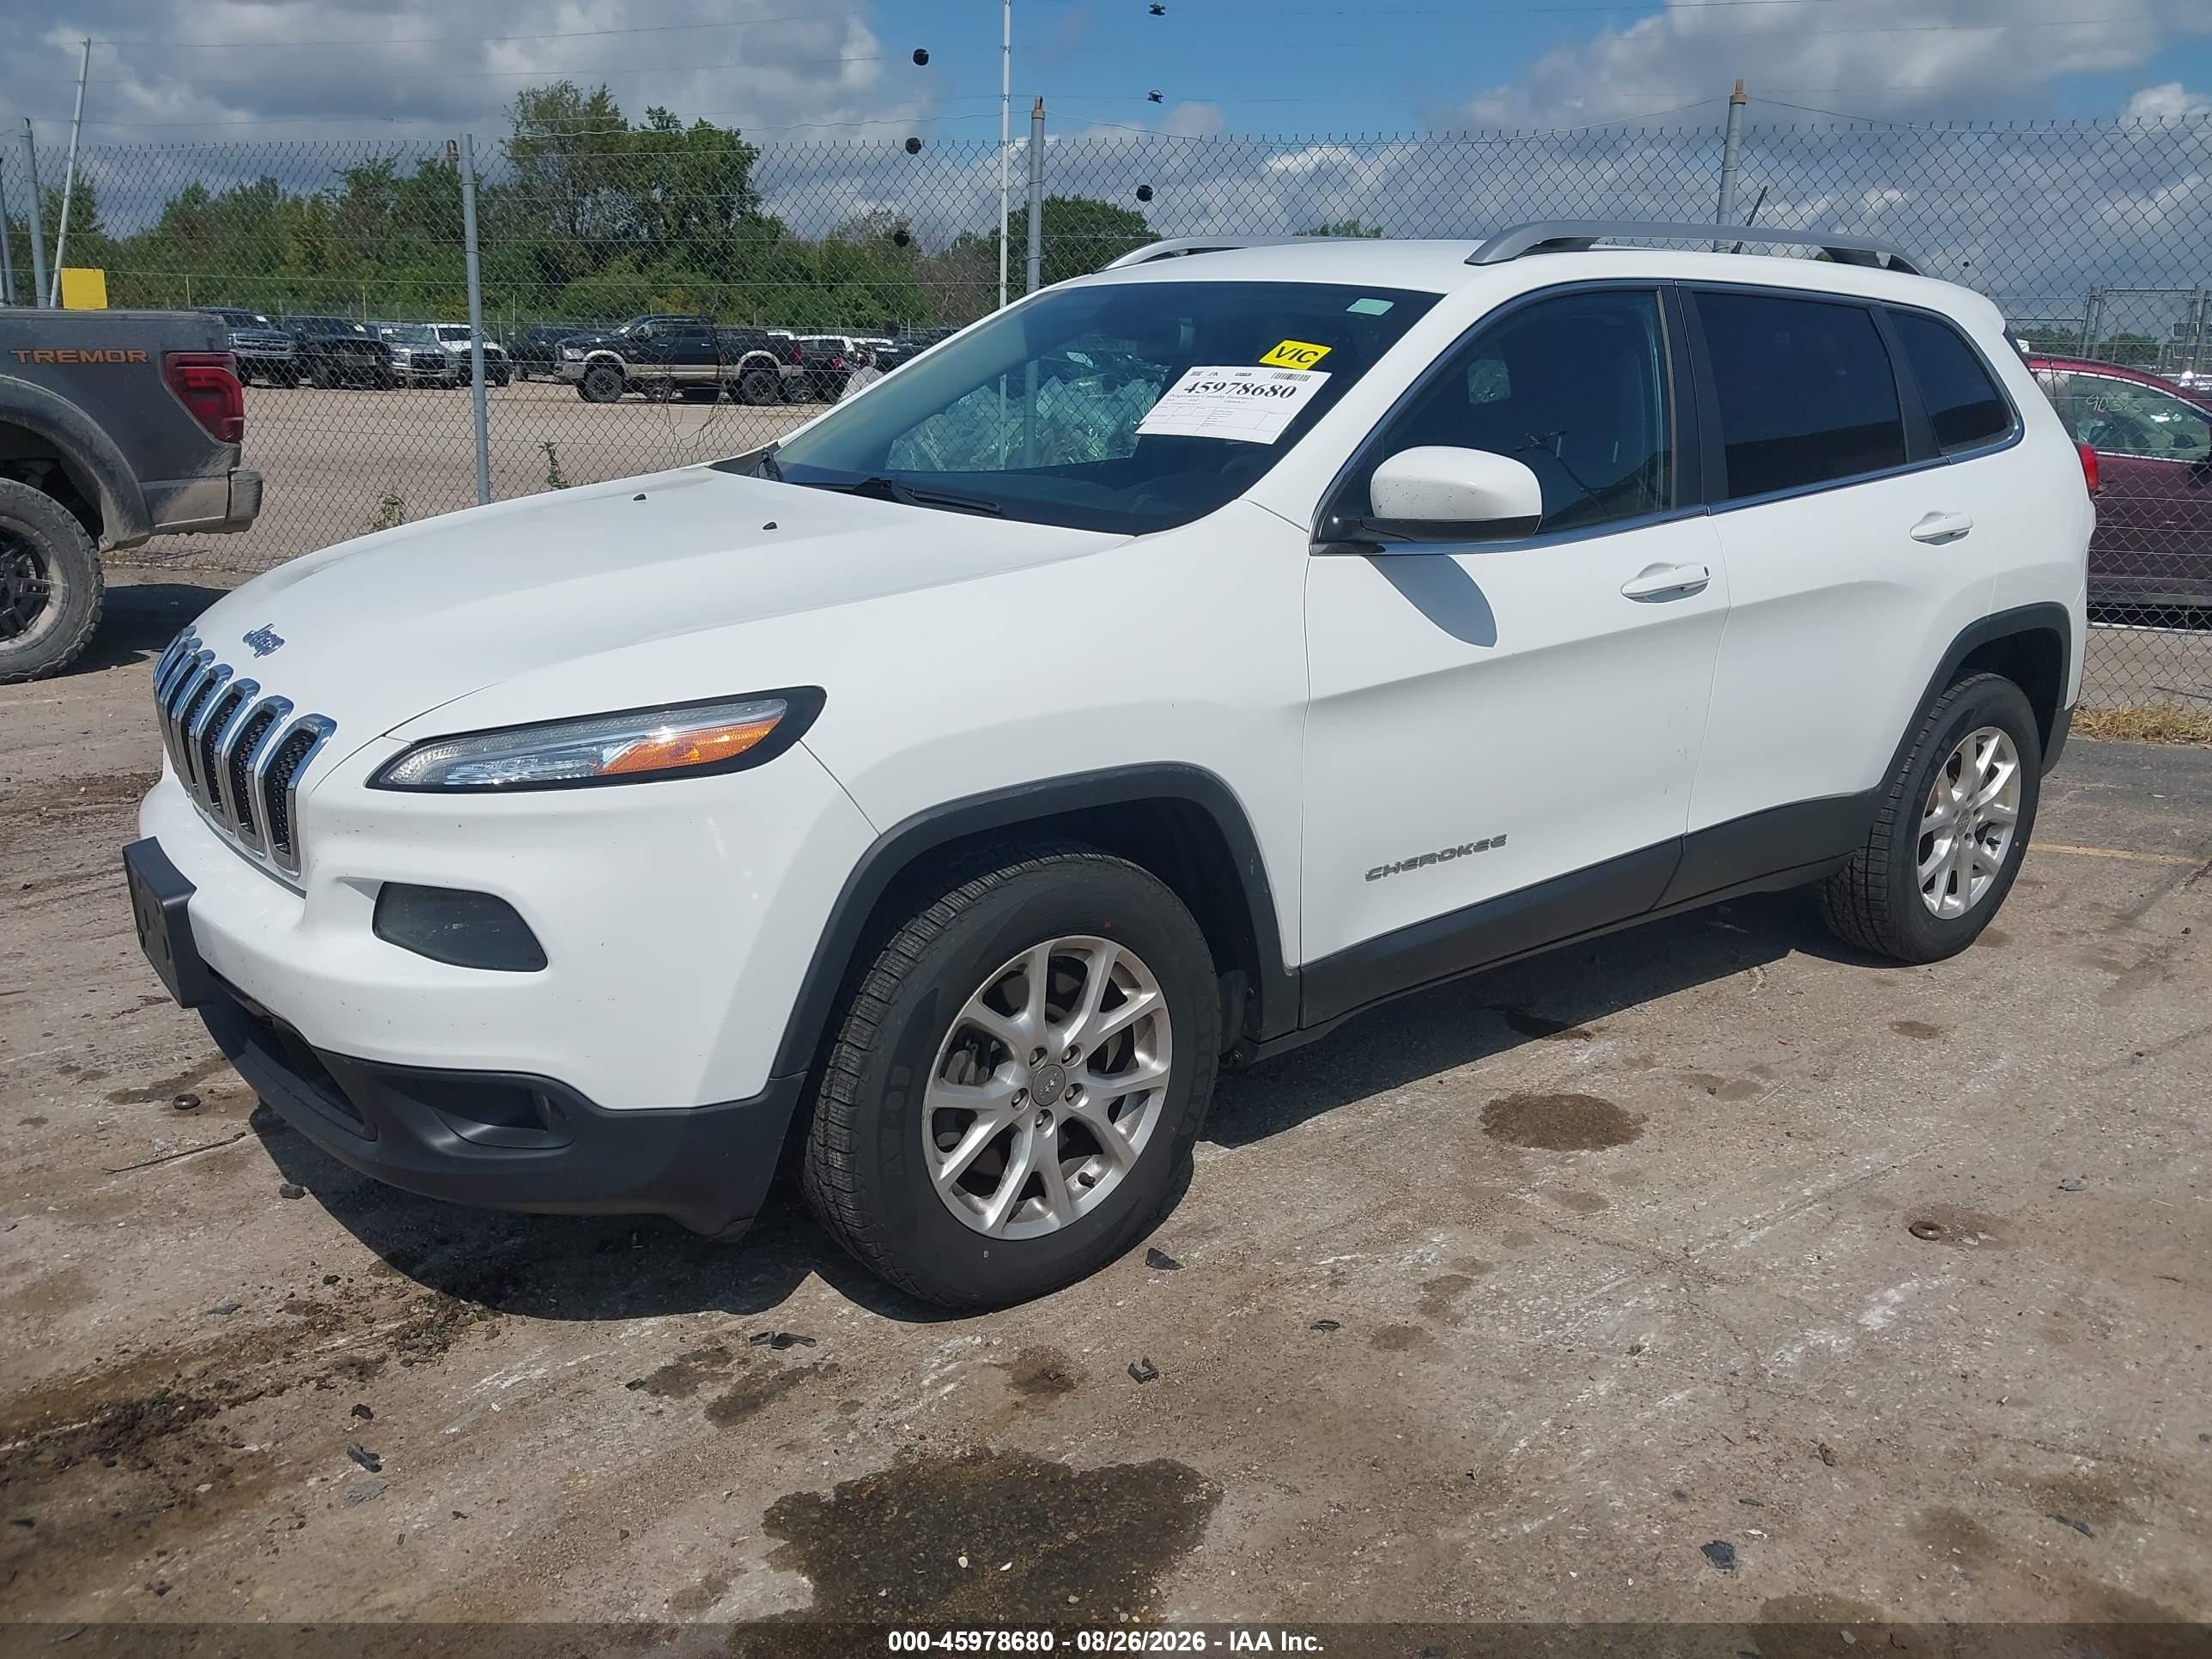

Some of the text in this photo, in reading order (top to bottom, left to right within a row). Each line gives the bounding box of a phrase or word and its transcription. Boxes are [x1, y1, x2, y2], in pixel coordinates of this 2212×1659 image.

[9, 349, 149, 364] TREMOR
[1275, 346, 1320, 363] VIC
[1184, 380, 1297, 399] 45978680
[1364, 834, 1508, 882] CHEROKEE
